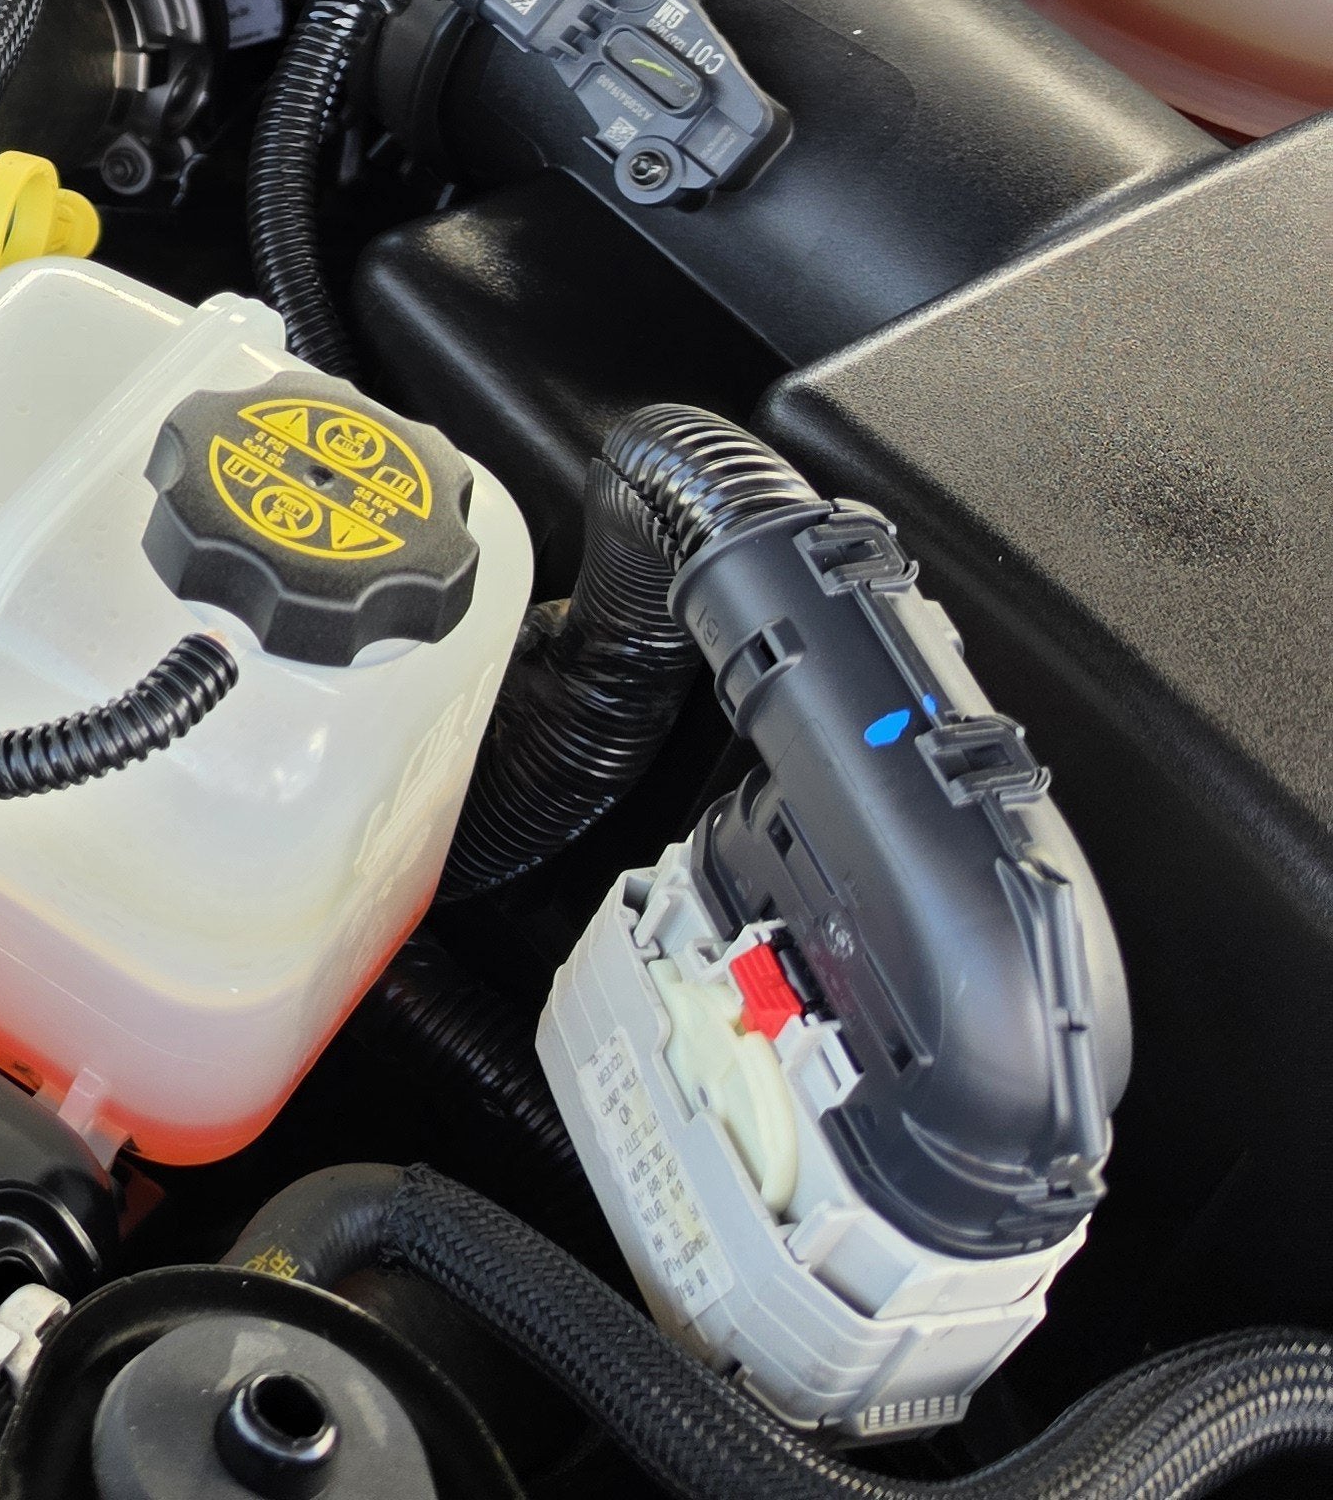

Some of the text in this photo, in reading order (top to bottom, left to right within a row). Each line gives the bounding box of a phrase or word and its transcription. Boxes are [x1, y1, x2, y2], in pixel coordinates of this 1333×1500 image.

[654, 0, 687, 29] GM
[686, 39, 726, 75] C01
[242, 438, 267, 458] kPa
[265, 437, 289, 453] PSI
[372, 496, 398, 516] kPa
